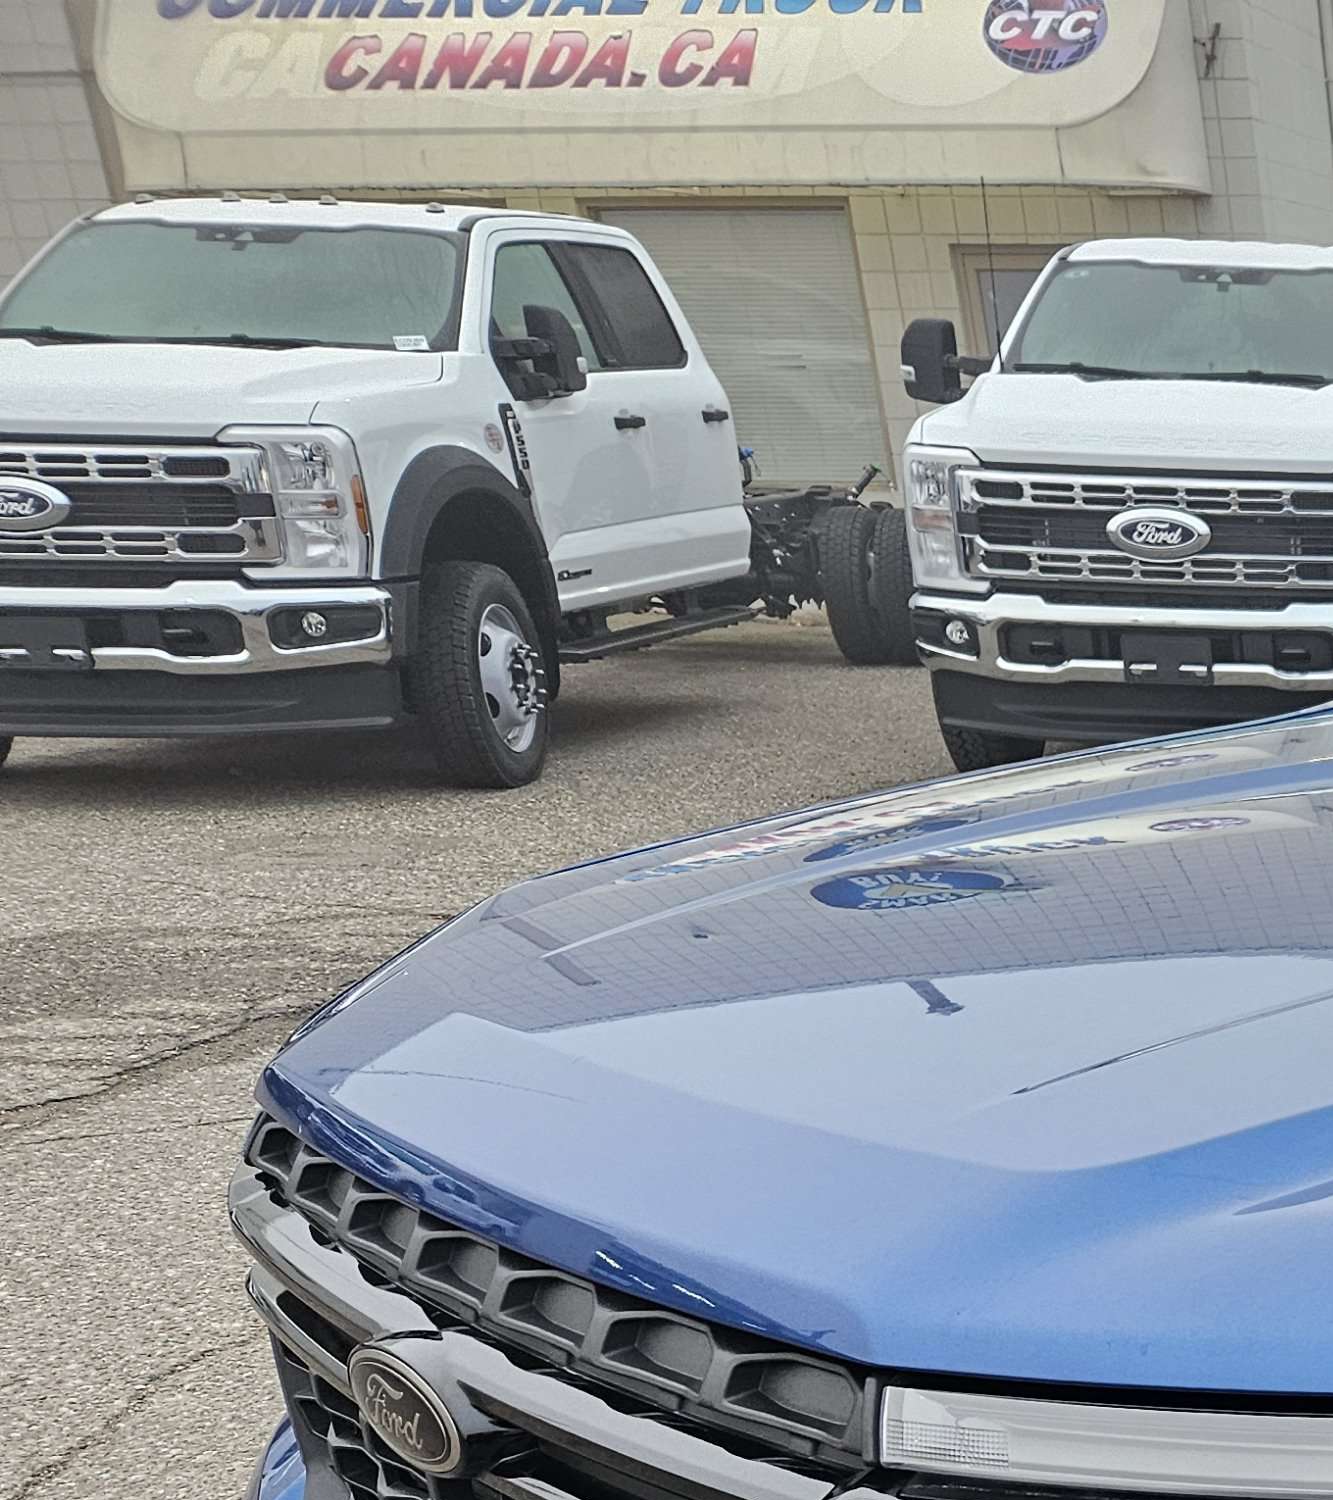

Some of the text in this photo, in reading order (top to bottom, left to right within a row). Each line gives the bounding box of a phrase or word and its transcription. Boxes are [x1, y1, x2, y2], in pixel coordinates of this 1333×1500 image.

[986, 8, 1098, 41] CTC
[323, 28, 759, 92] CANADA.CA
[1132, 521, 1183, 545] Ford
[364, 1372, 425, 1451] Ford
